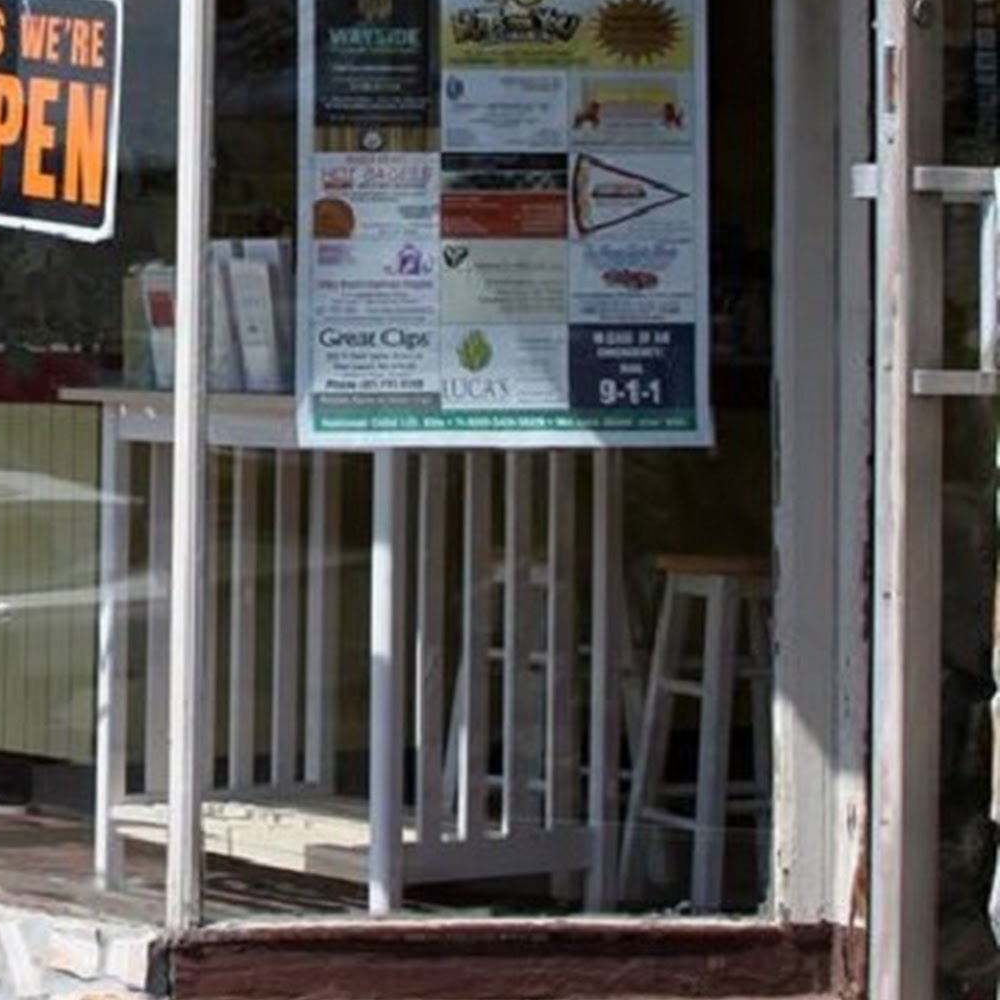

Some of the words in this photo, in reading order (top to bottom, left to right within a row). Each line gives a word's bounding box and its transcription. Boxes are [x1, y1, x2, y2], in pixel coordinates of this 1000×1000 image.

[20, 14, 105, 69] WE'RE
[318, 327, 376, 348] Great
[380, 327, 430, 350] Clips
[599, 378, 662, 405] 9-1-1
